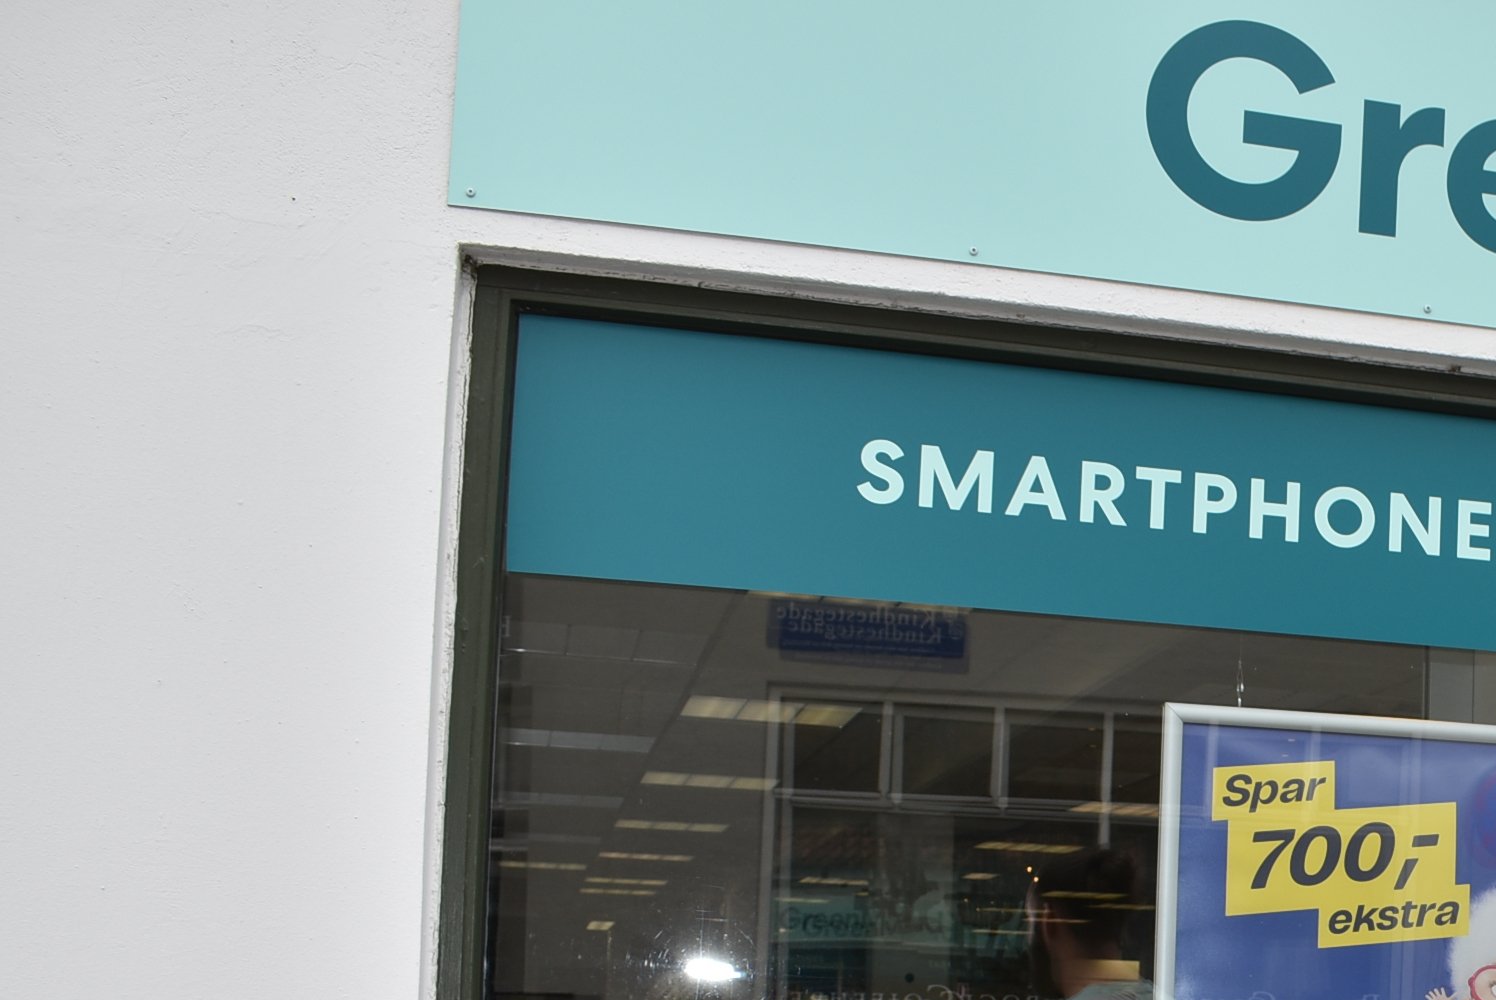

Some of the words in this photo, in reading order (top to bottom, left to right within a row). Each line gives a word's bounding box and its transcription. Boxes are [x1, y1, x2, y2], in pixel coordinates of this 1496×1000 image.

[1222, 774, 1327, 813] Spar
[1250, 821, 1440, 891] 700,-
[1328, 900, 1460, 935] ekstra
